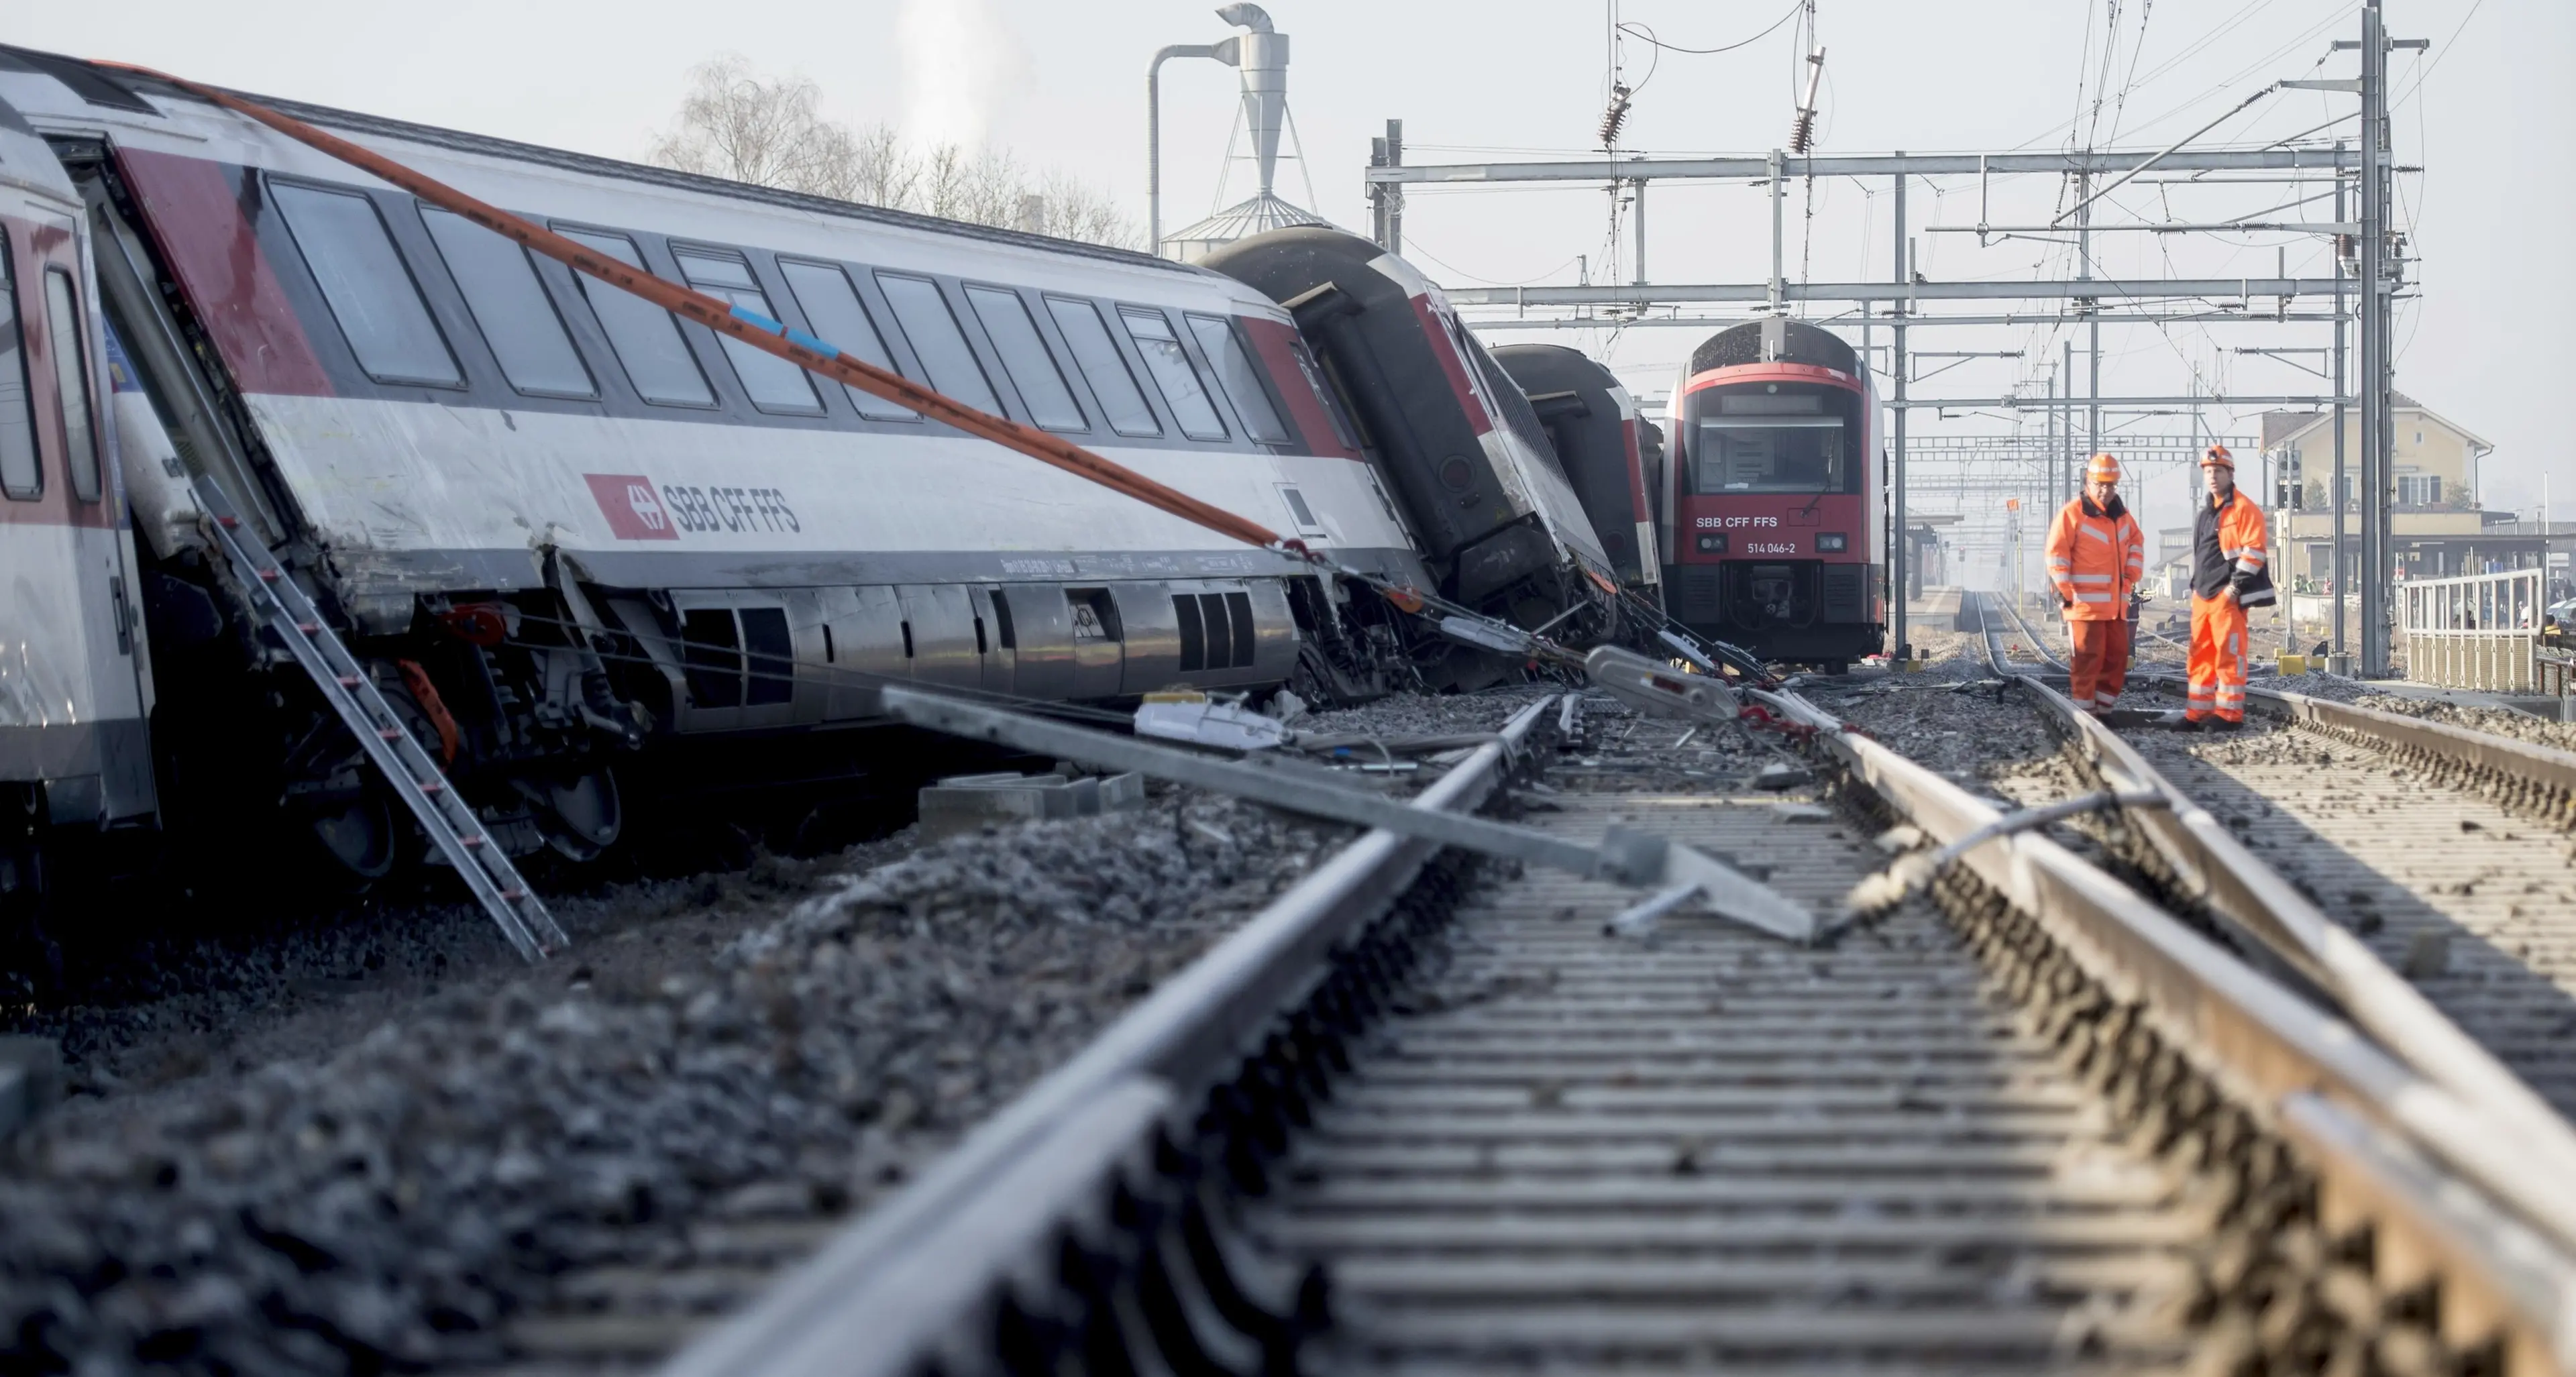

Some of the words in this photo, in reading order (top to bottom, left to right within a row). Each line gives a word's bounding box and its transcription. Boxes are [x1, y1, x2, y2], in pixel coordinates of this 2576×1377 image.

[663, 485, 720, 532] SBB
[710, 487, 758, 533] CFF
[749, 488, 800, 533] FFS
[1696, 517, 1722, 528] SBB
[1725, 517, 1750, 528] CFF
[1754, 516, 1778, 527] FFS
[1748, 543, 1765, 553] 514
[1767, 543, 1795, 553] 046-2
